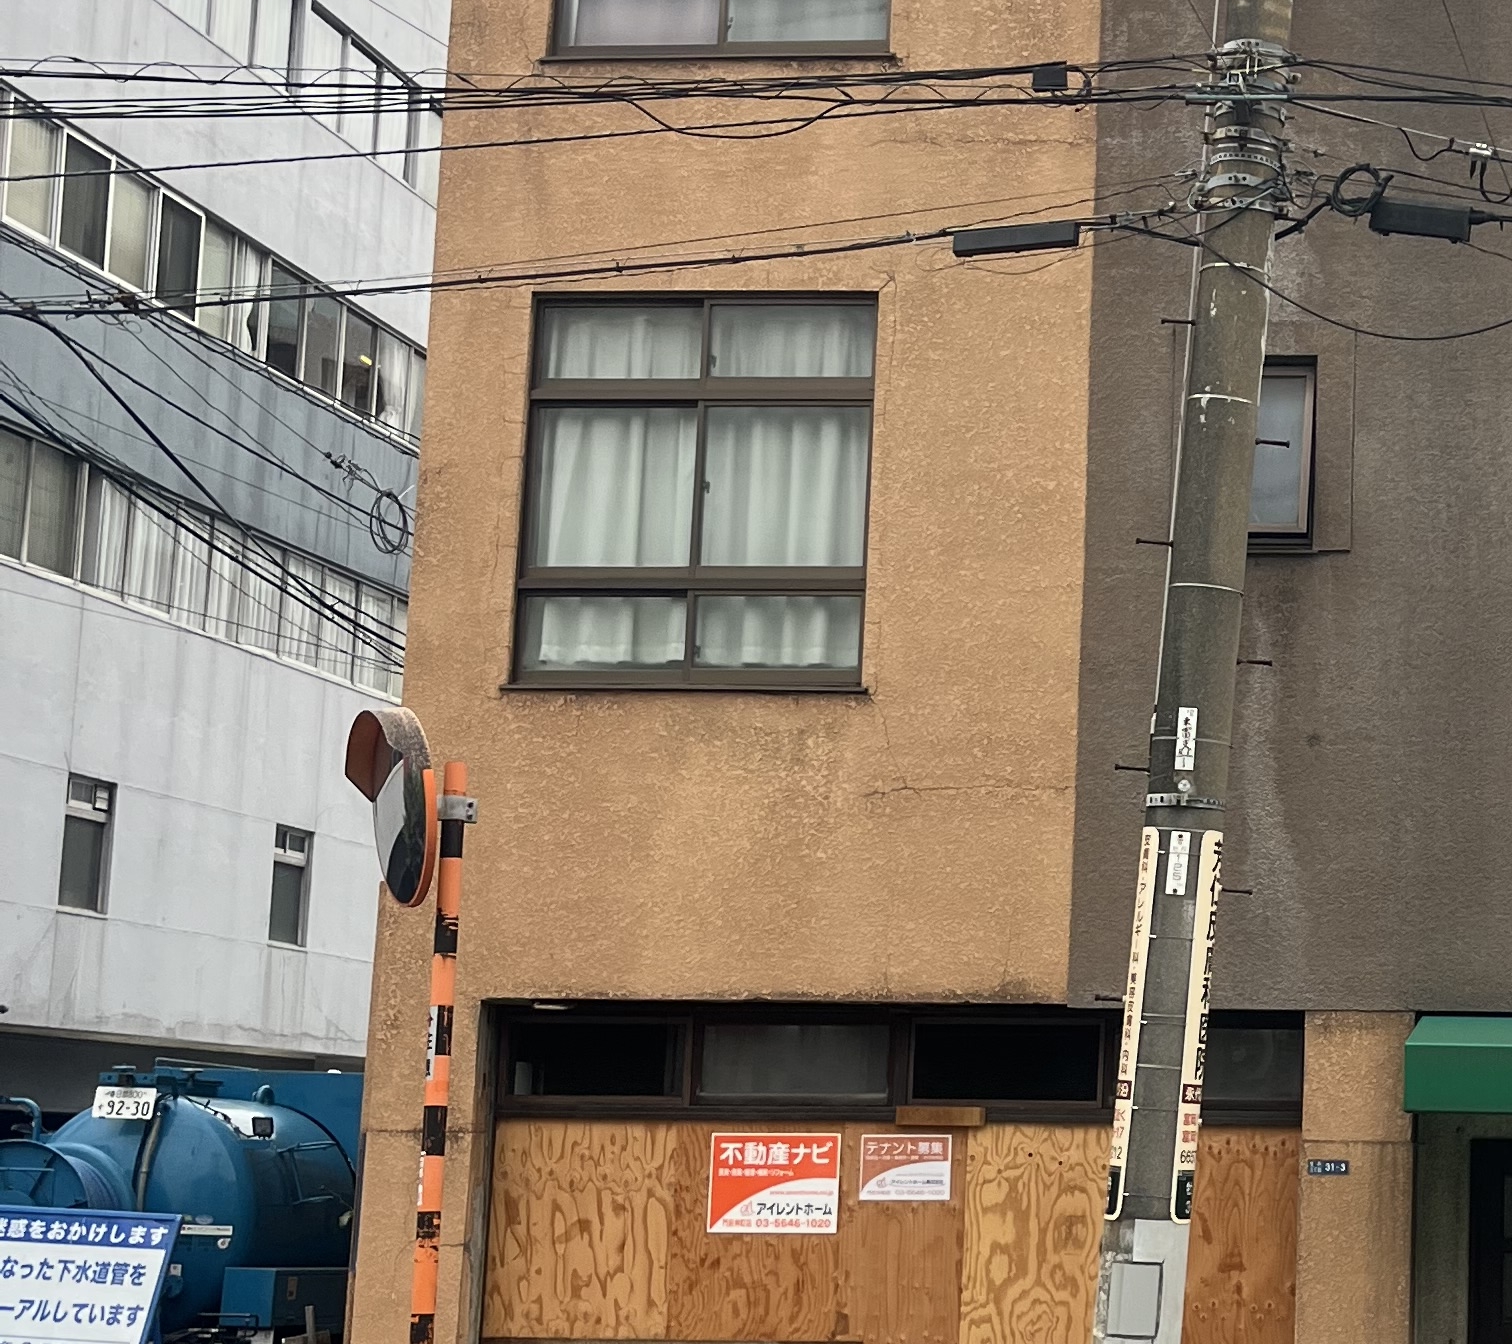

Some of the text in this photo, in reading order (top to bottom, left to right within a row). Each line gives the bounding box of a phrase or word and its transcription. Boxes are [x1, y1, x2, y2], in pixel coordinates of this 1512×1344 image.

[106, 1100, 150, 1117] 92-30
[719, 1141, 834, 1166] 不動産ナビ
[866, 1141, 943, 1155] テナント募集
[757, 1203, 833, 1216] アイレントホーム
[756, 1219, 831, 1228] 03-5646-1020
